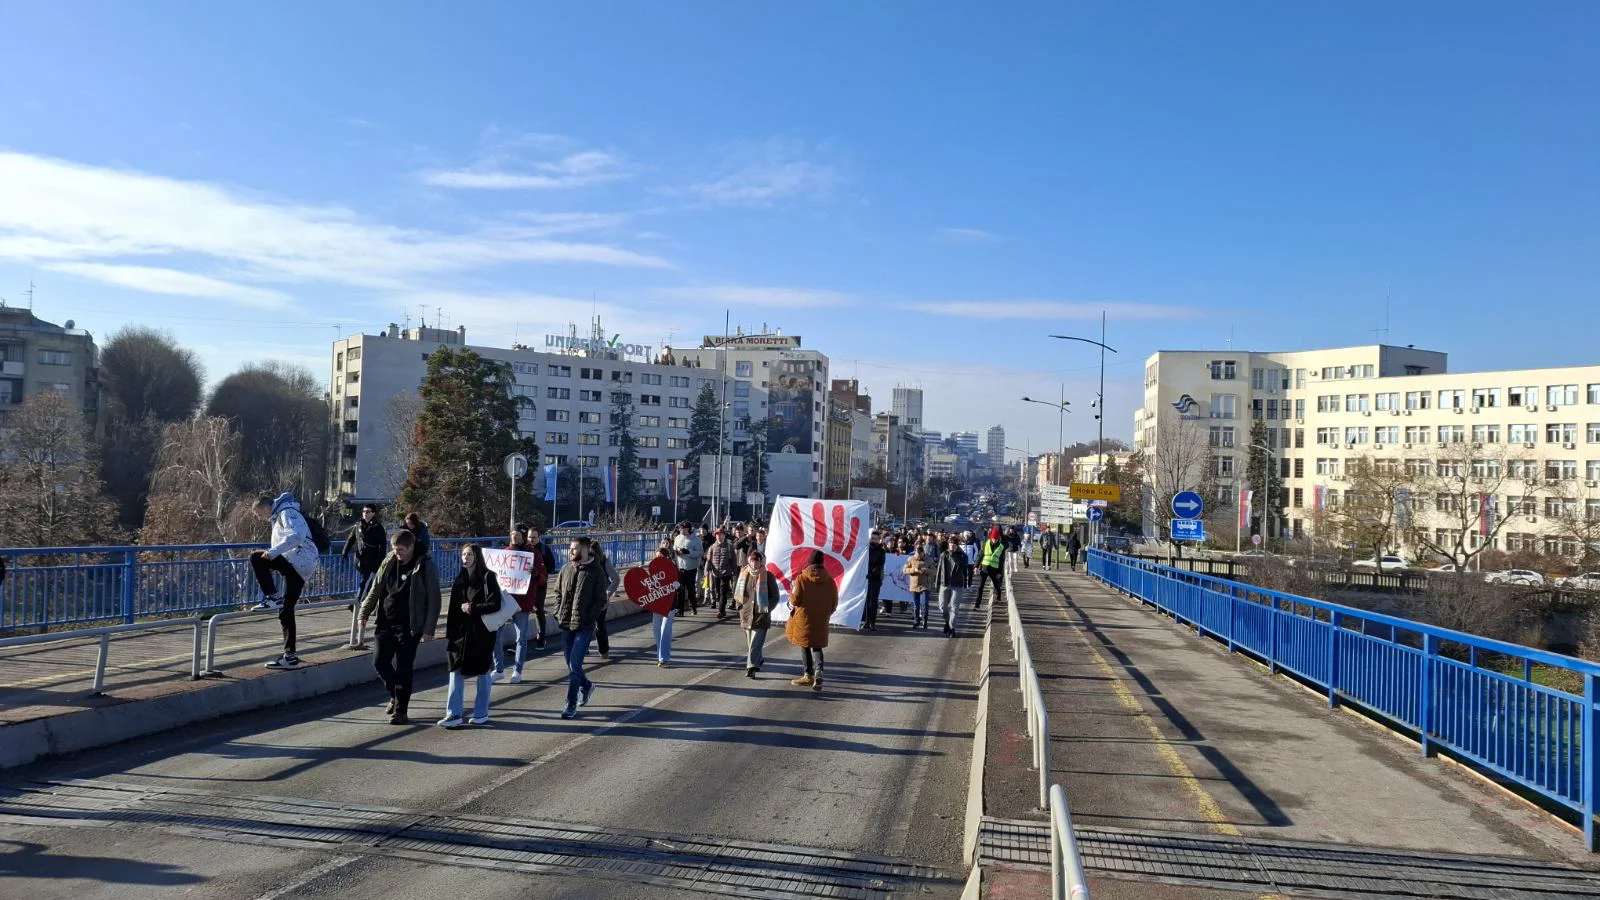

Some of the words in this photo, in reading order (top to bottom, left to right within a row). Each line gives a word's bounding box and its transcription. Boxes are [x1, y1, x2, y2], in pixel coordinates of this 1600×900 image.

[746, 337, 788, 345] MORETTI
[485, 553, 532, 572] ЛАЖЕТЕ
[640, 570, 666, 587] VELIKO
